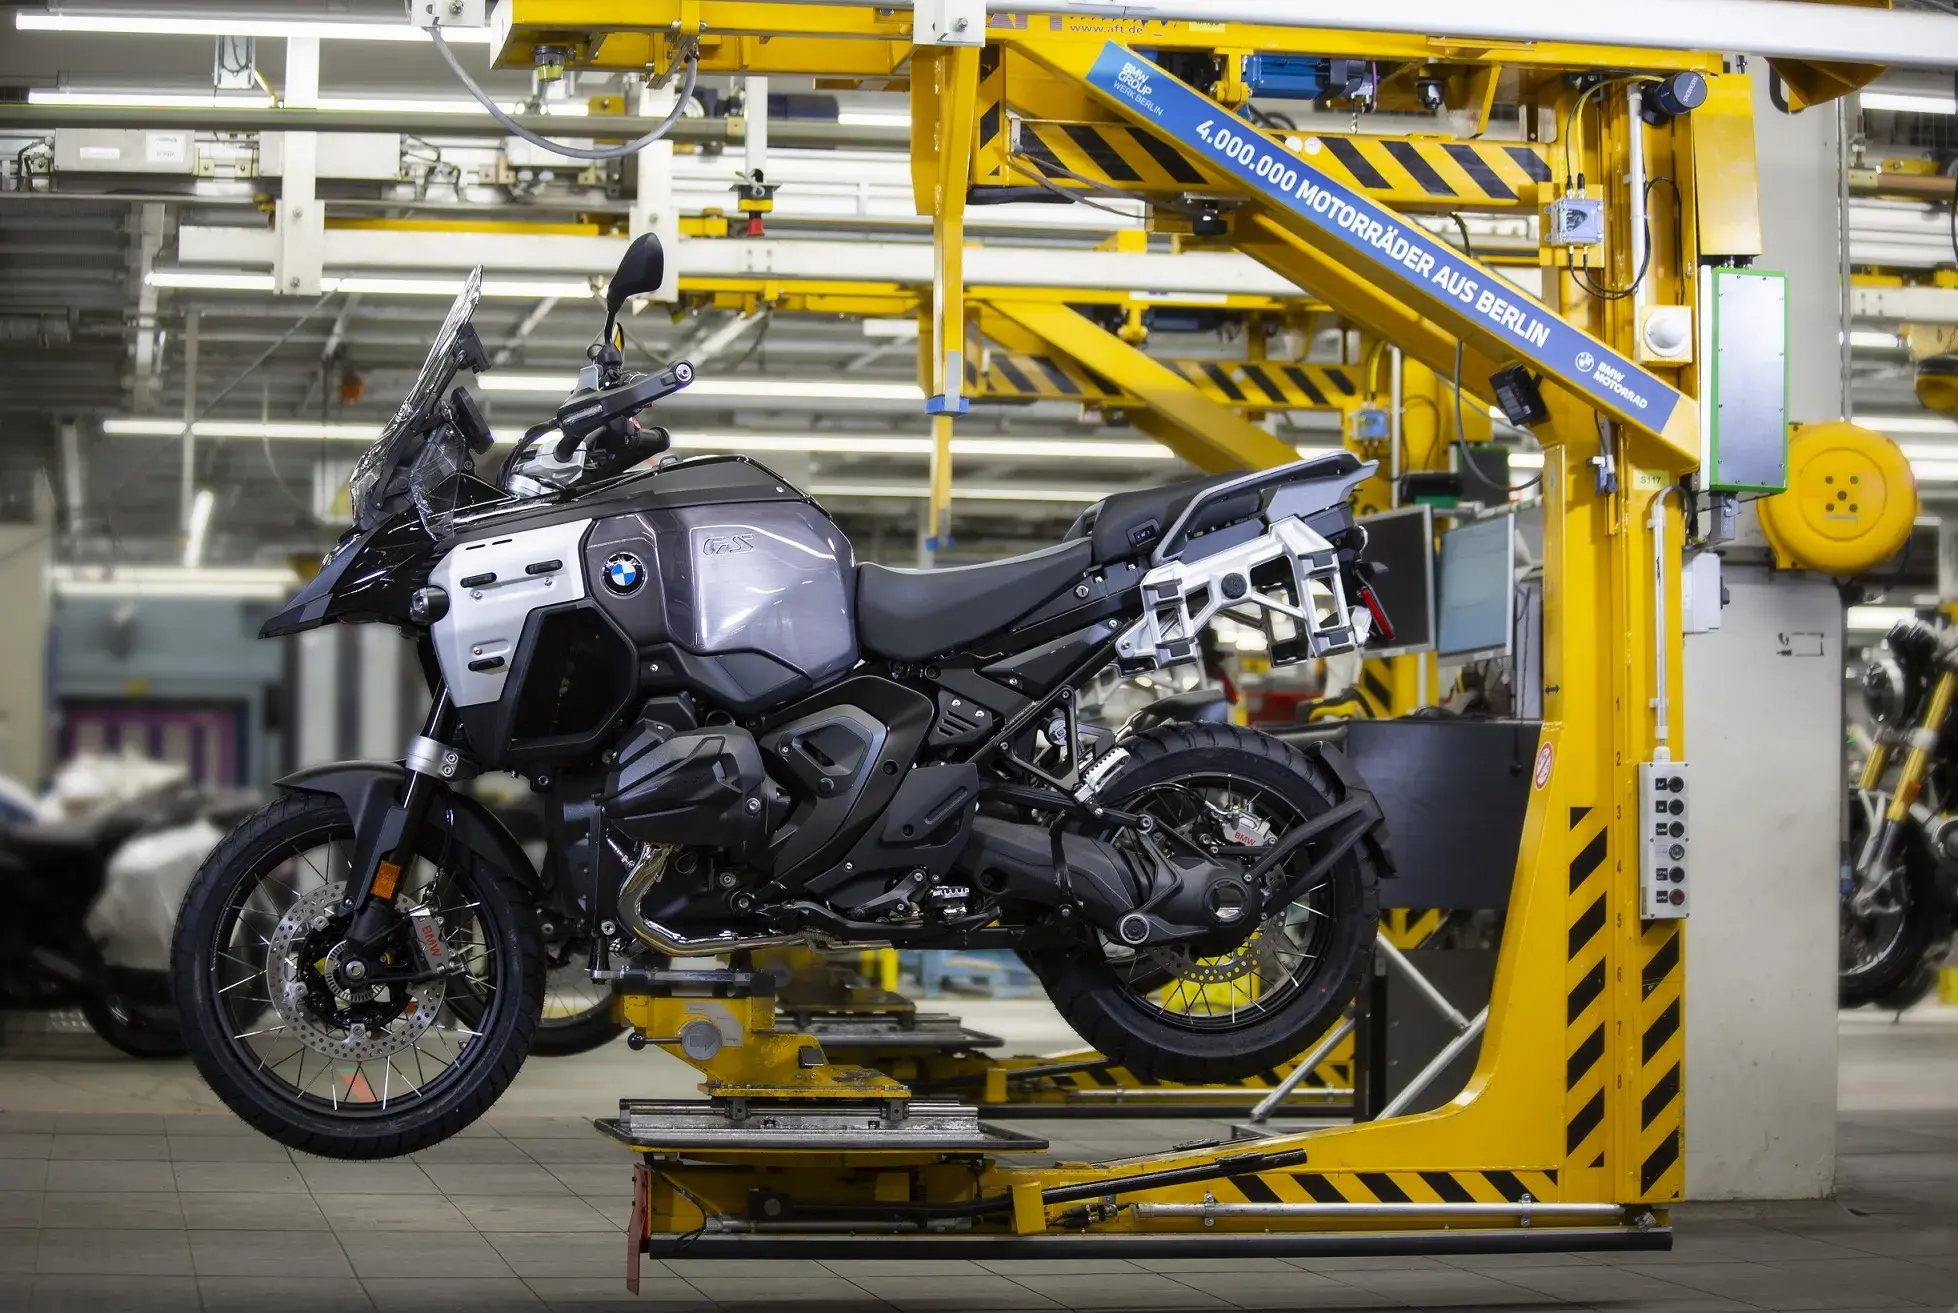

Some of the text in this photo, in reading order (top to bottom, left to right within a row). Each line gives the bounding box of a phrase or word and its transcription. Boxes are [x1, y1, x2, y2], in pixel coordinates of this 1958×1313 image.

[1118, 71, 1152, 95] GROUP
[1122, 62, 1149, 83] BMW
[1113, 80, 1164, 116] WERK BERLIN
[1195, 119, 1551, 349] 4.000.000 MOTORRÄDER AUS BERLIN
[1597, 361, 1626, 383] BMW
[1592, 370, 1648, 409] MOTORRAD
[702, 533, 755, 557] GS
[1615, 751, 1622, 767] 2
[1616, 804, 1622, 821] 3
[1234, 832, 1256, 846] BMW
[1616, 859, 1622, 875] 4
[422, 925, 441, 956] BMW
[1617, 1020, 1623, 1036] 7
